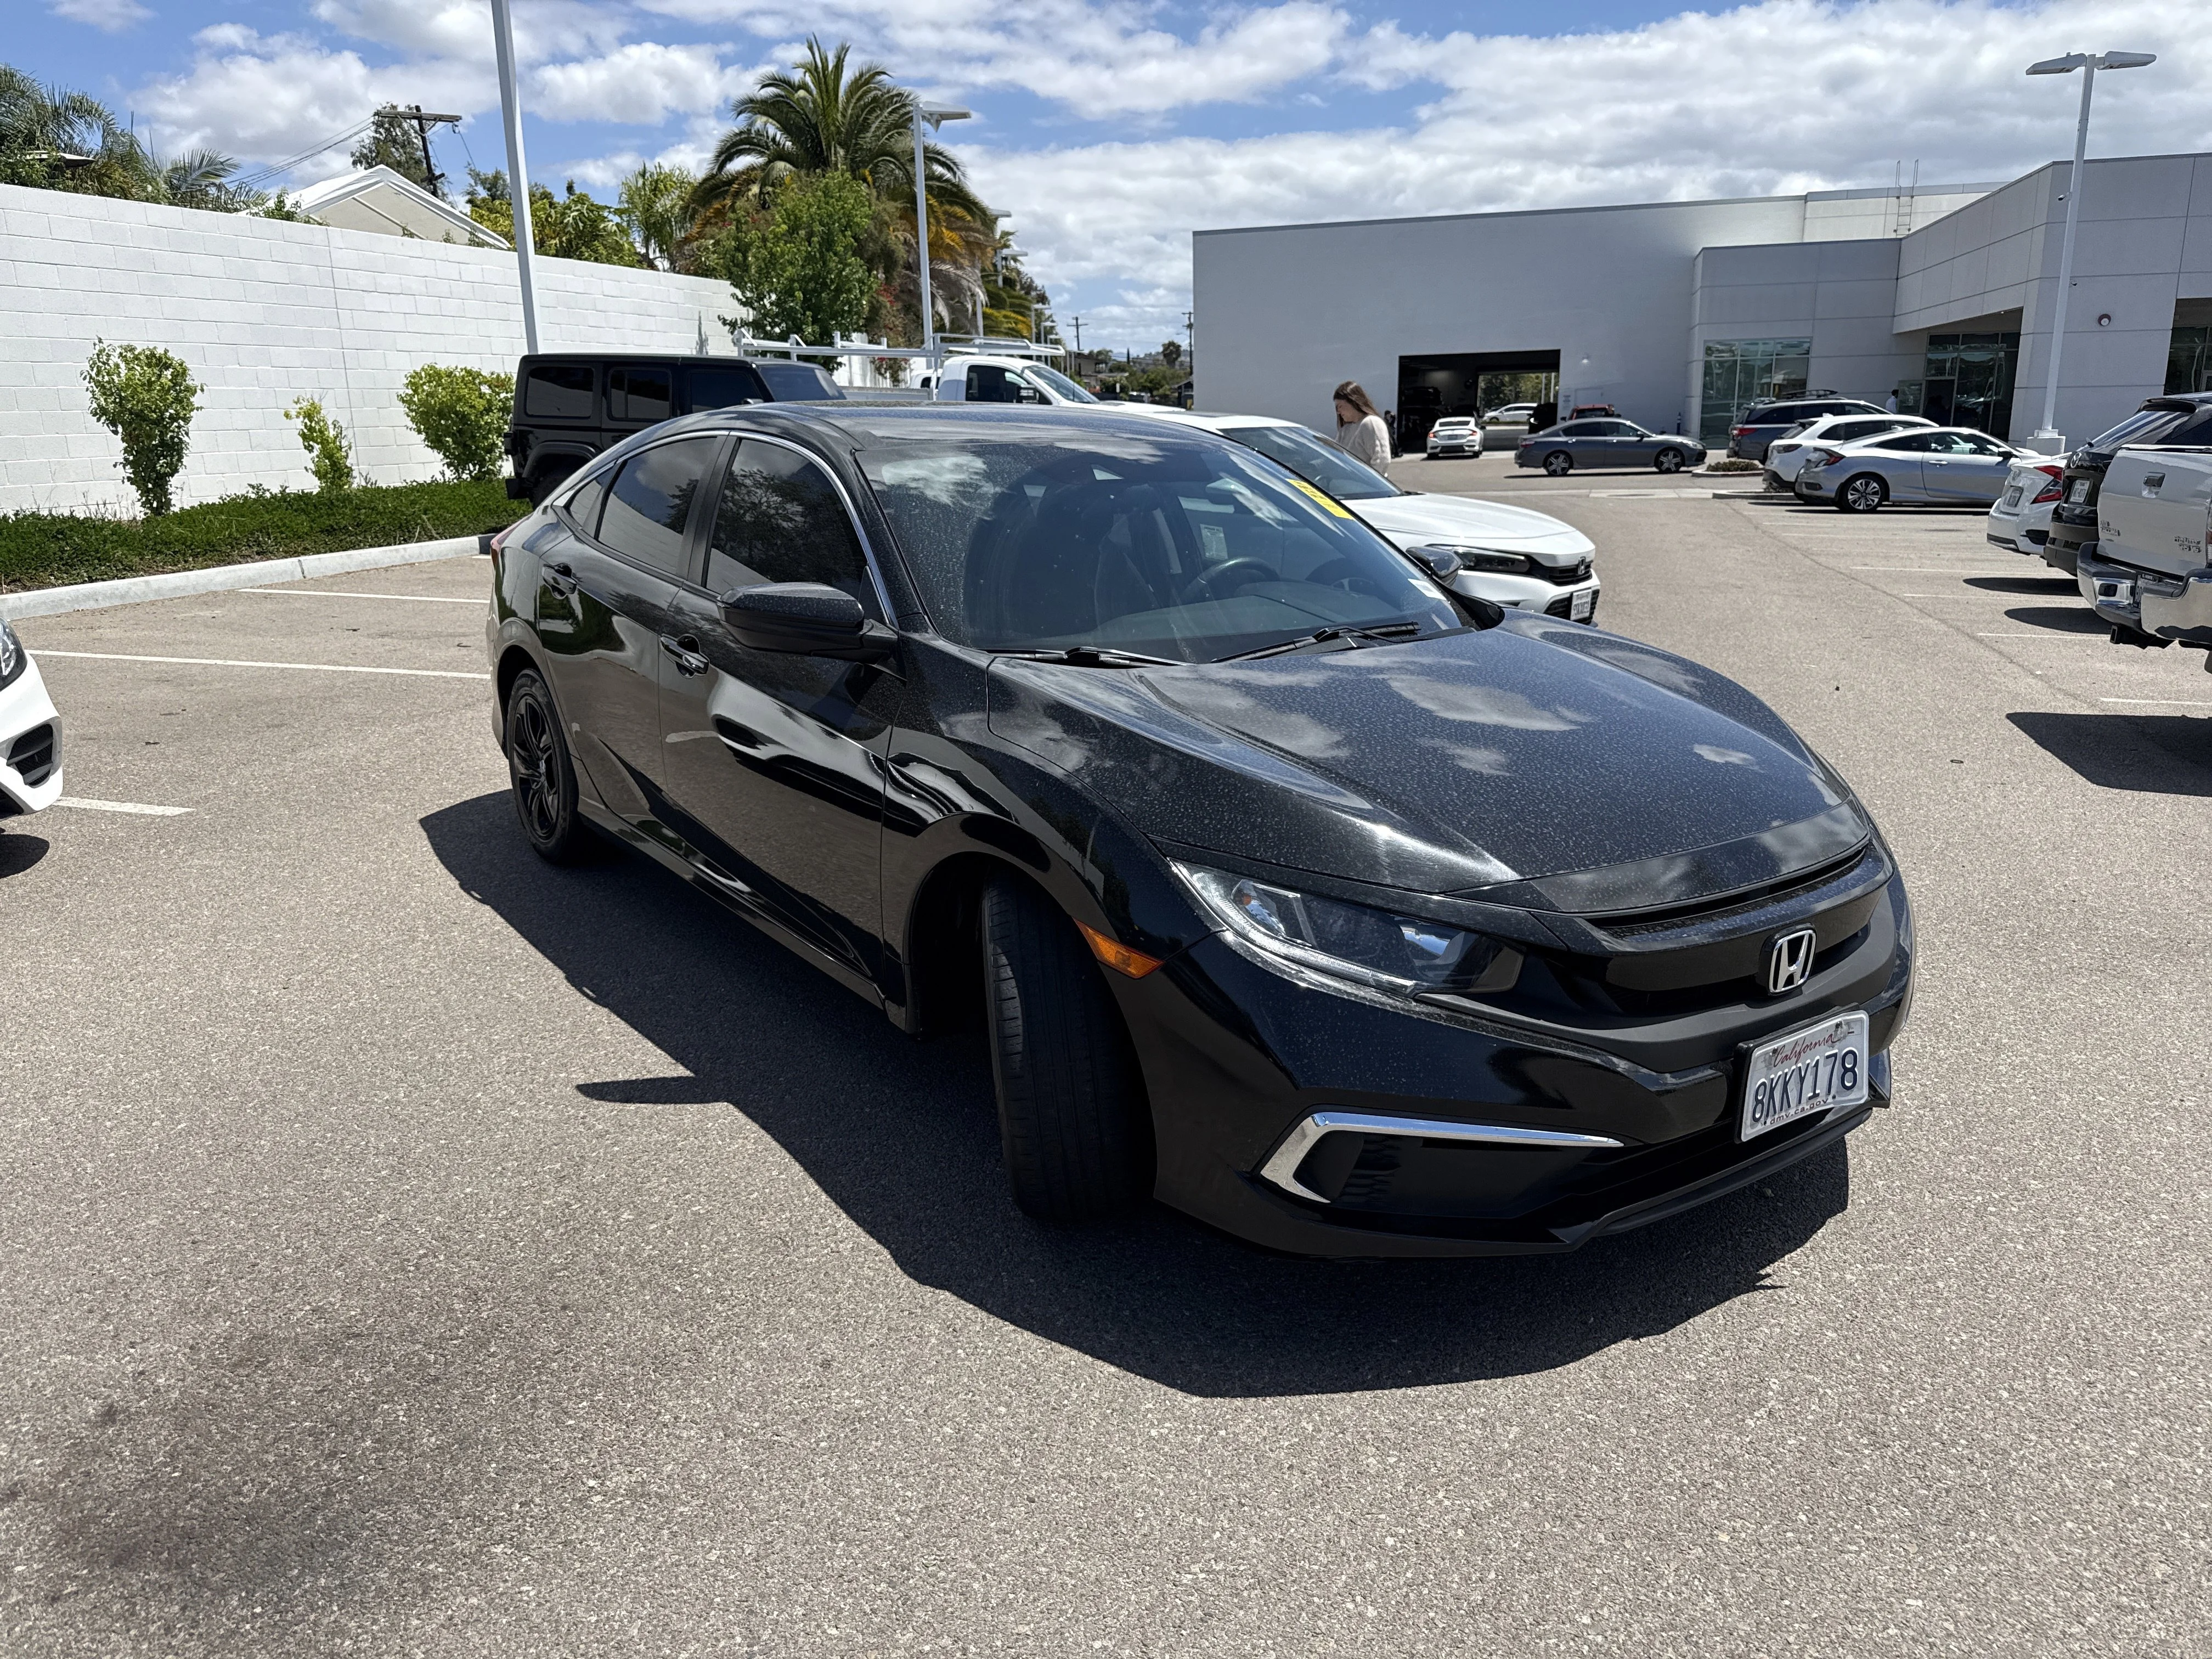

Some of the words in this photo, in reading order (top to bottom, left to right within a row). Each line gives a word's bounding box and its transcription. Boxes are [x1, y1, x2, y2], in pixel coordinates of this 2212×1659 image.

[1773, 1029, 1839, 1068] California
[1752, 1048, 1858, 1122] 8KKY178
[1770, 1097, 1829, 1125] dmv.ca.gov
